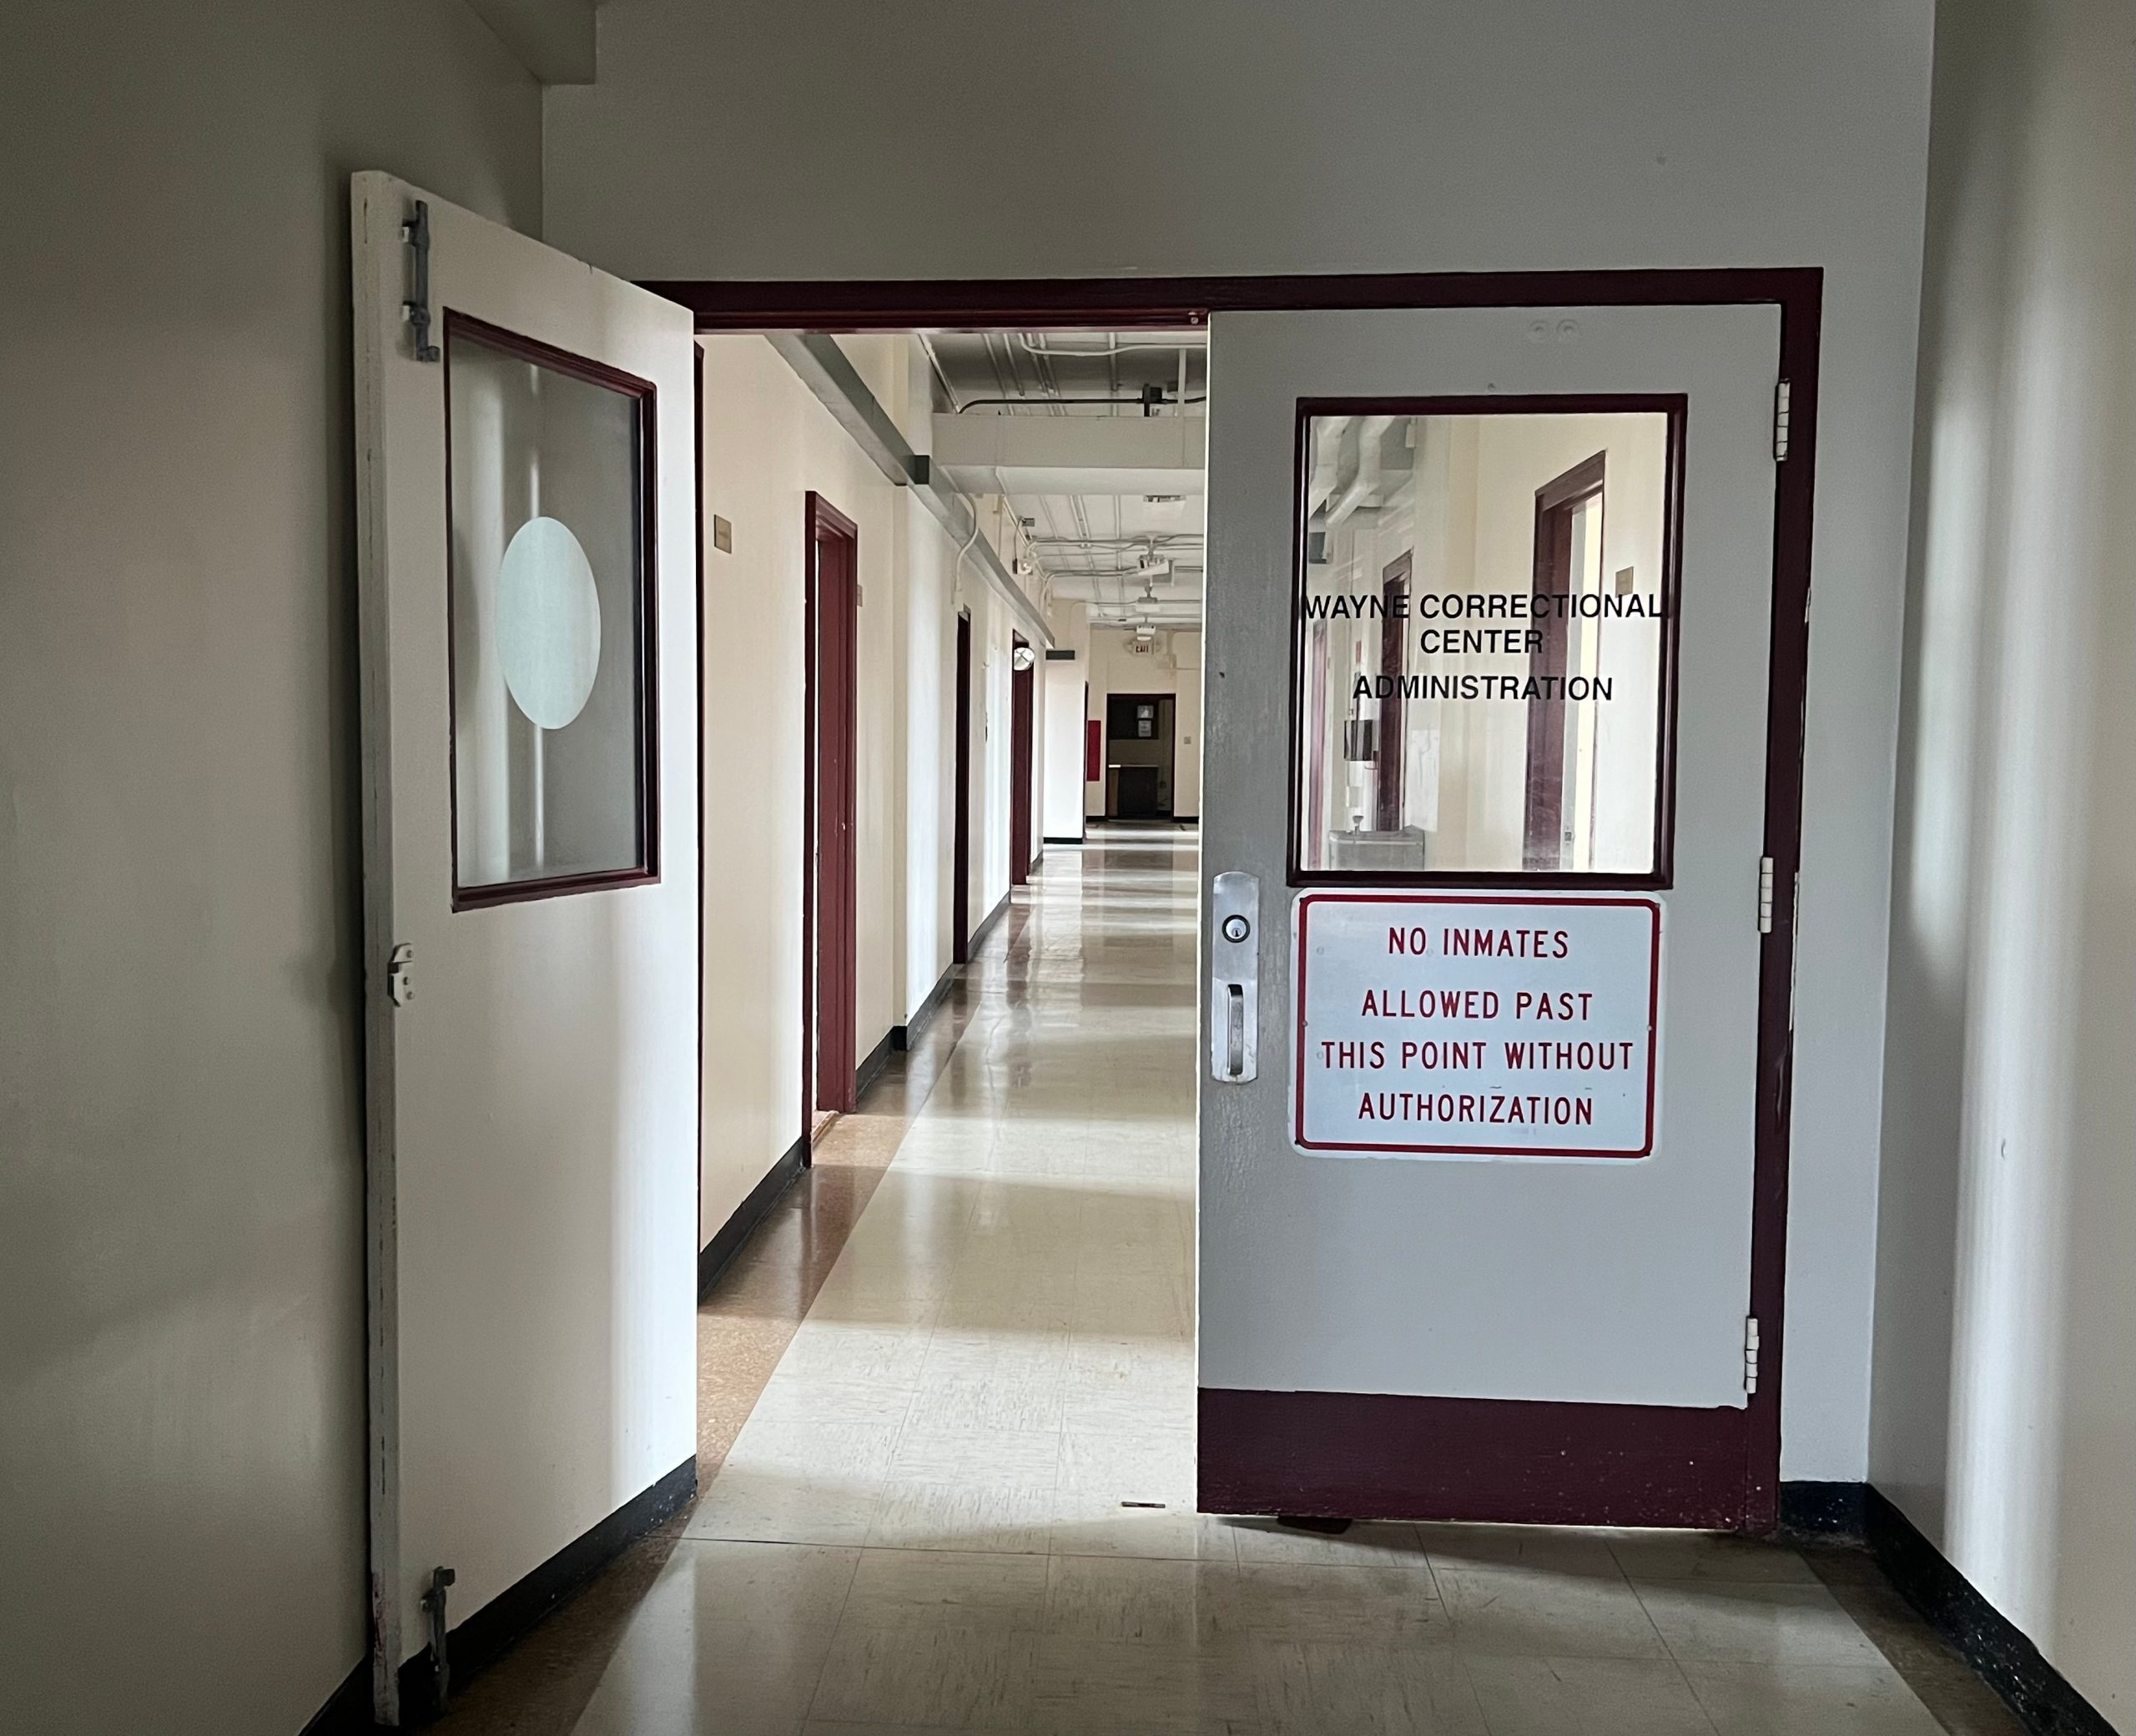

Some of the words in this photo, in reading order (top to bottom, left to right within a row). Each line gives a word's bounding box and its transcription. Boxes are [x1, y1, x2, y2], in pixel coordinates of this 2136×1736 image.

[1303, 594, 1410, 619] WAYNE
[1419, 593, 1665, 619] CORRECTIONAL
[1420, 629, 1543, 654] CENTER
[1353, 675, 1612, 701] ADMINISTRATION
[1388, 927, 1426, 955] NO
[1443, 928, 1569, 959] INMATES
[1362, 989, 1499, 1019] ALLOWED
[1515, 992, 1593, 1021] PAST
[1321, 1041, 1385, 1069] THIS
[1402, 1041, 1486, 1069] POINT
[1504, 1042, 1634, 1070] WITHOUT
[1358, 1092, 1593, 1125] AUTHORIZATION
